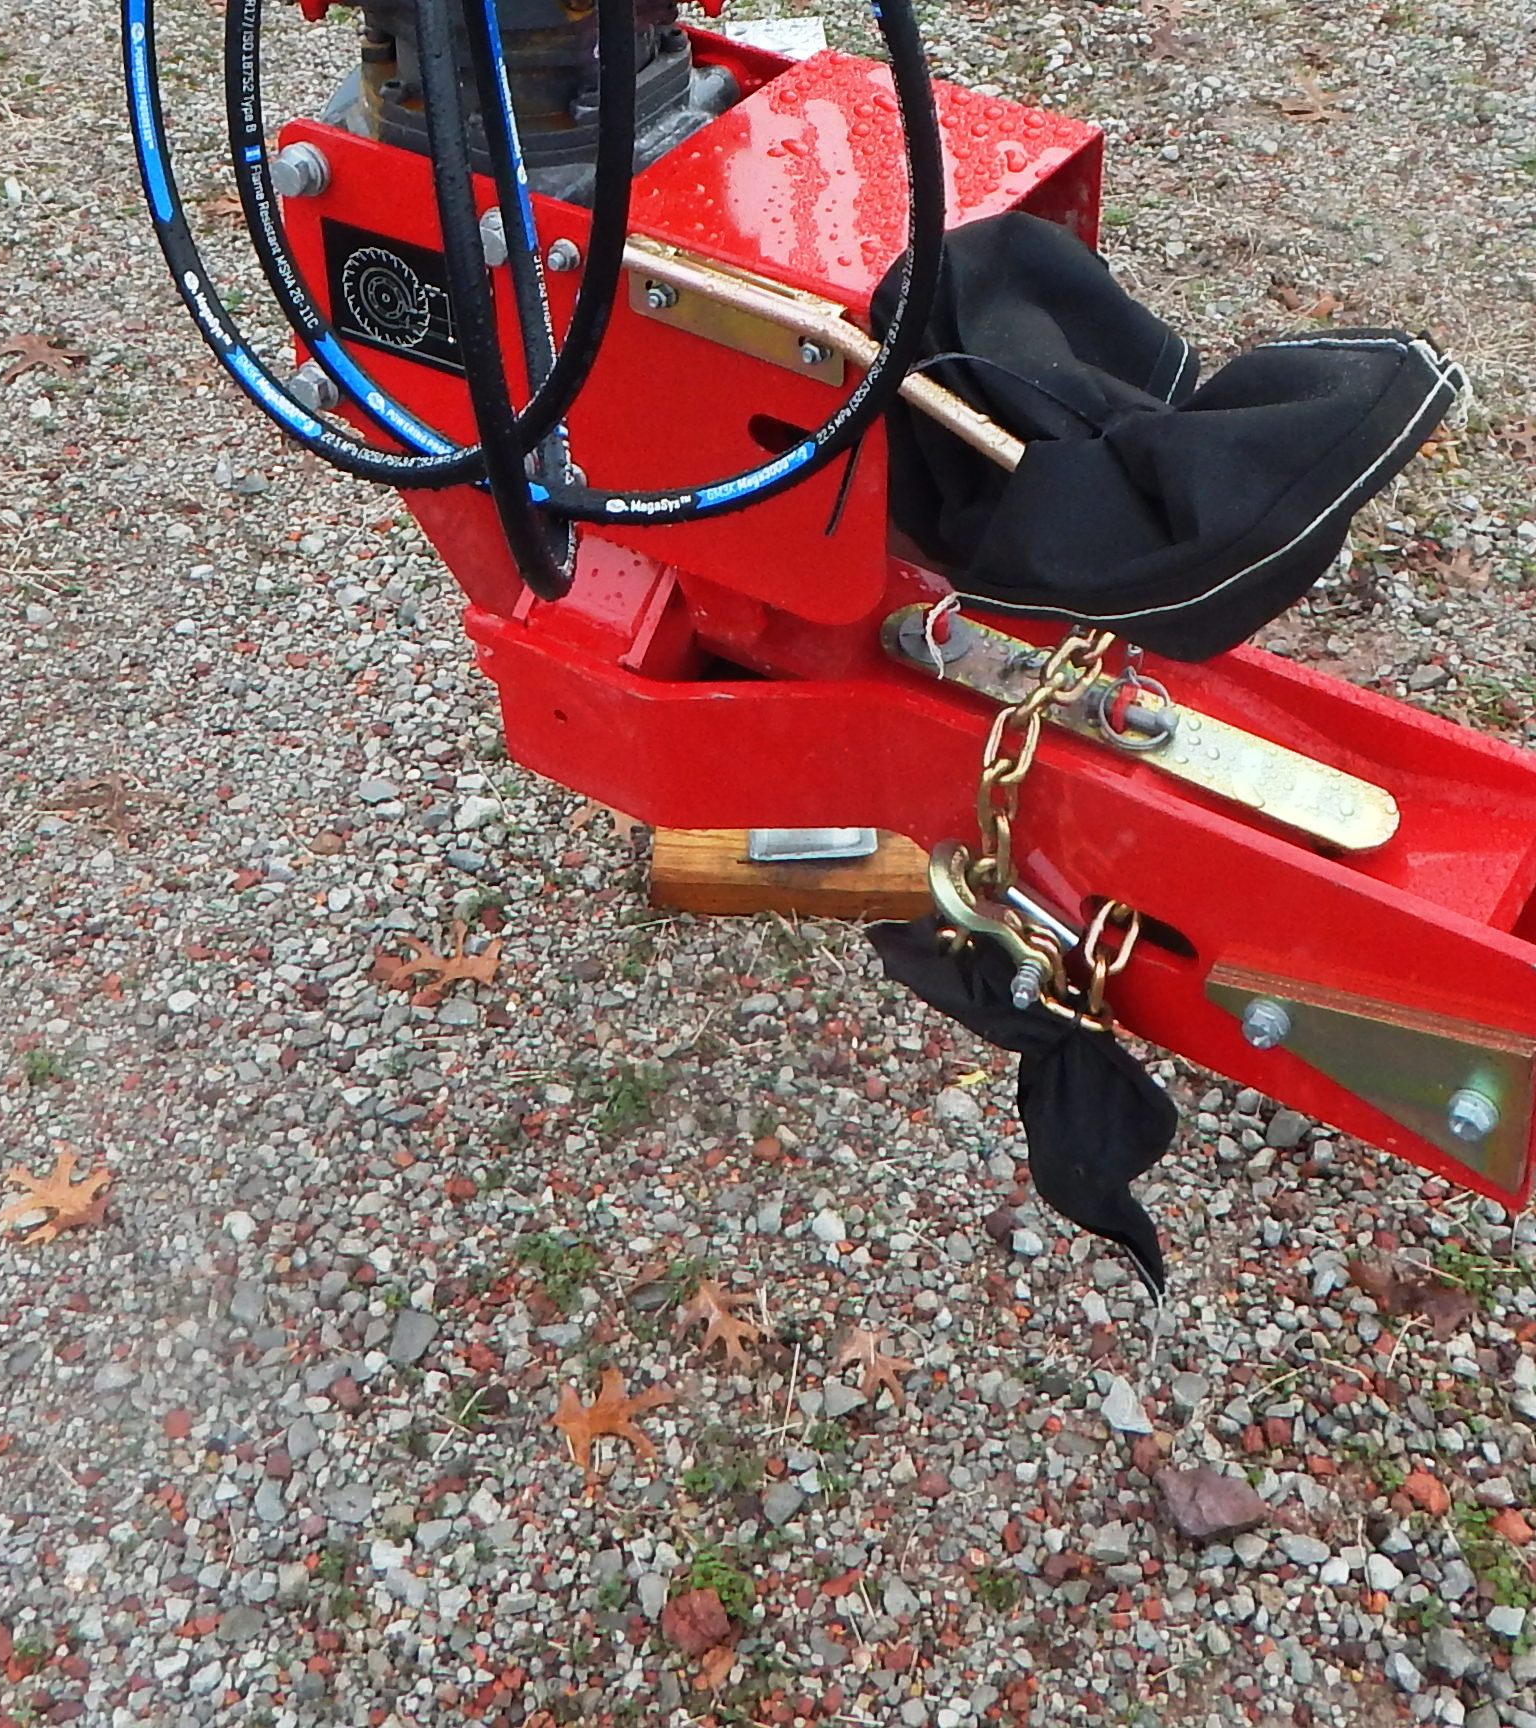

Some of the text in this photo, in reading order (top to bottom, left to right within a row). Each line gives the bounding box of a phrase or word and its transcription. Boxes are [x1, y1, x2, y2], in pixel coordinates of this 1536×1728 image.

[240, 30, 255, 53] ISO
[240, 53, 255, 94] 18752
[239, 93, 256, 123] Type
[244, 122, 257, 134] B
[249, 164, 266, 201] Flame
[257, 200, 282, 257] Resistant
[274, 255, 297, 291] MSHA
[288, 288, 320, 330] 2G-11C
